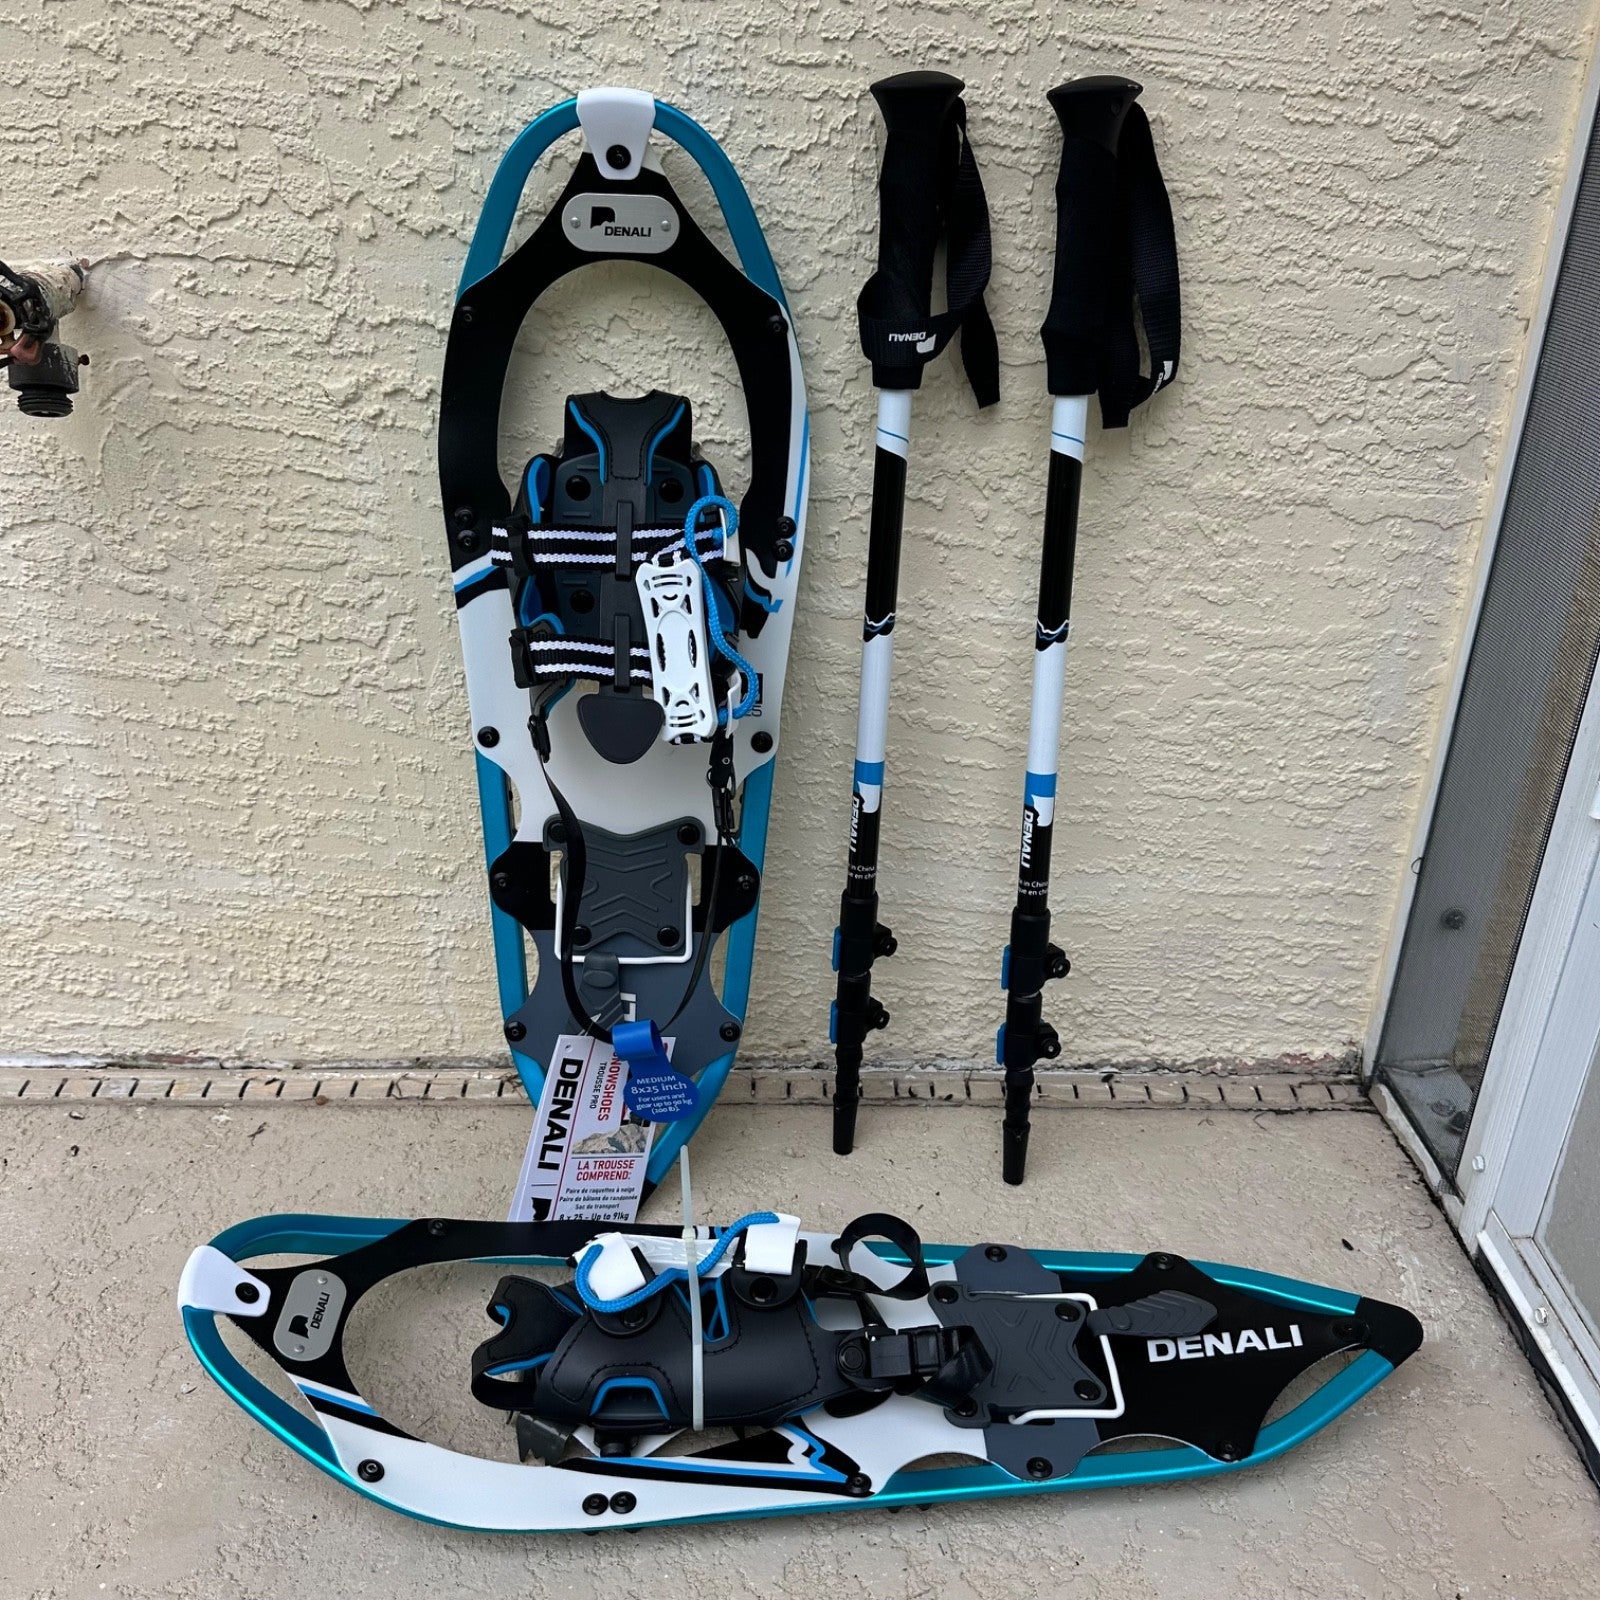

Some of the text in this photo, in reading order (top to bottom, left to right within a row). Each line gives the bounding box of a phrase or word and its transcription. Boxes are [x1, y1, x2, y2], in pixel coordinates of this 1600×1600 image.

[604, 226, 651, 237] DENALI
[888, 331, 926, 343] DENALI
[850, 796, 860, 853] DENALI
[1021, 809, 1034, 869] DENALI
[589, 1061, 607, 1109] TROUSSE PRO
[636, 1075, 676, 1085] MEDIUM
[631, 1081, 687, 1095] 8x25 inch
[651, 1094, 671, 1102] users
[636, 1102, 652, 1111] gear
[683, 1098, 693, 1106] kg
[537, 1057, 584, 1171] DENALI
[577, 1160, 635, 1170] LA TROUSSE
[576, 1171, 632, 1181] COMPREND:
[589, 1187, 615, 1195] raquettes
[591, 1213, 601, 1221] Up
[603, 1212, 612, 1220] to
[613, 1211, 630, 1221] 91kg
[310, 1291, 331, 1329] DENALI
[1147, 1324, 1303, 1363] DENALI
